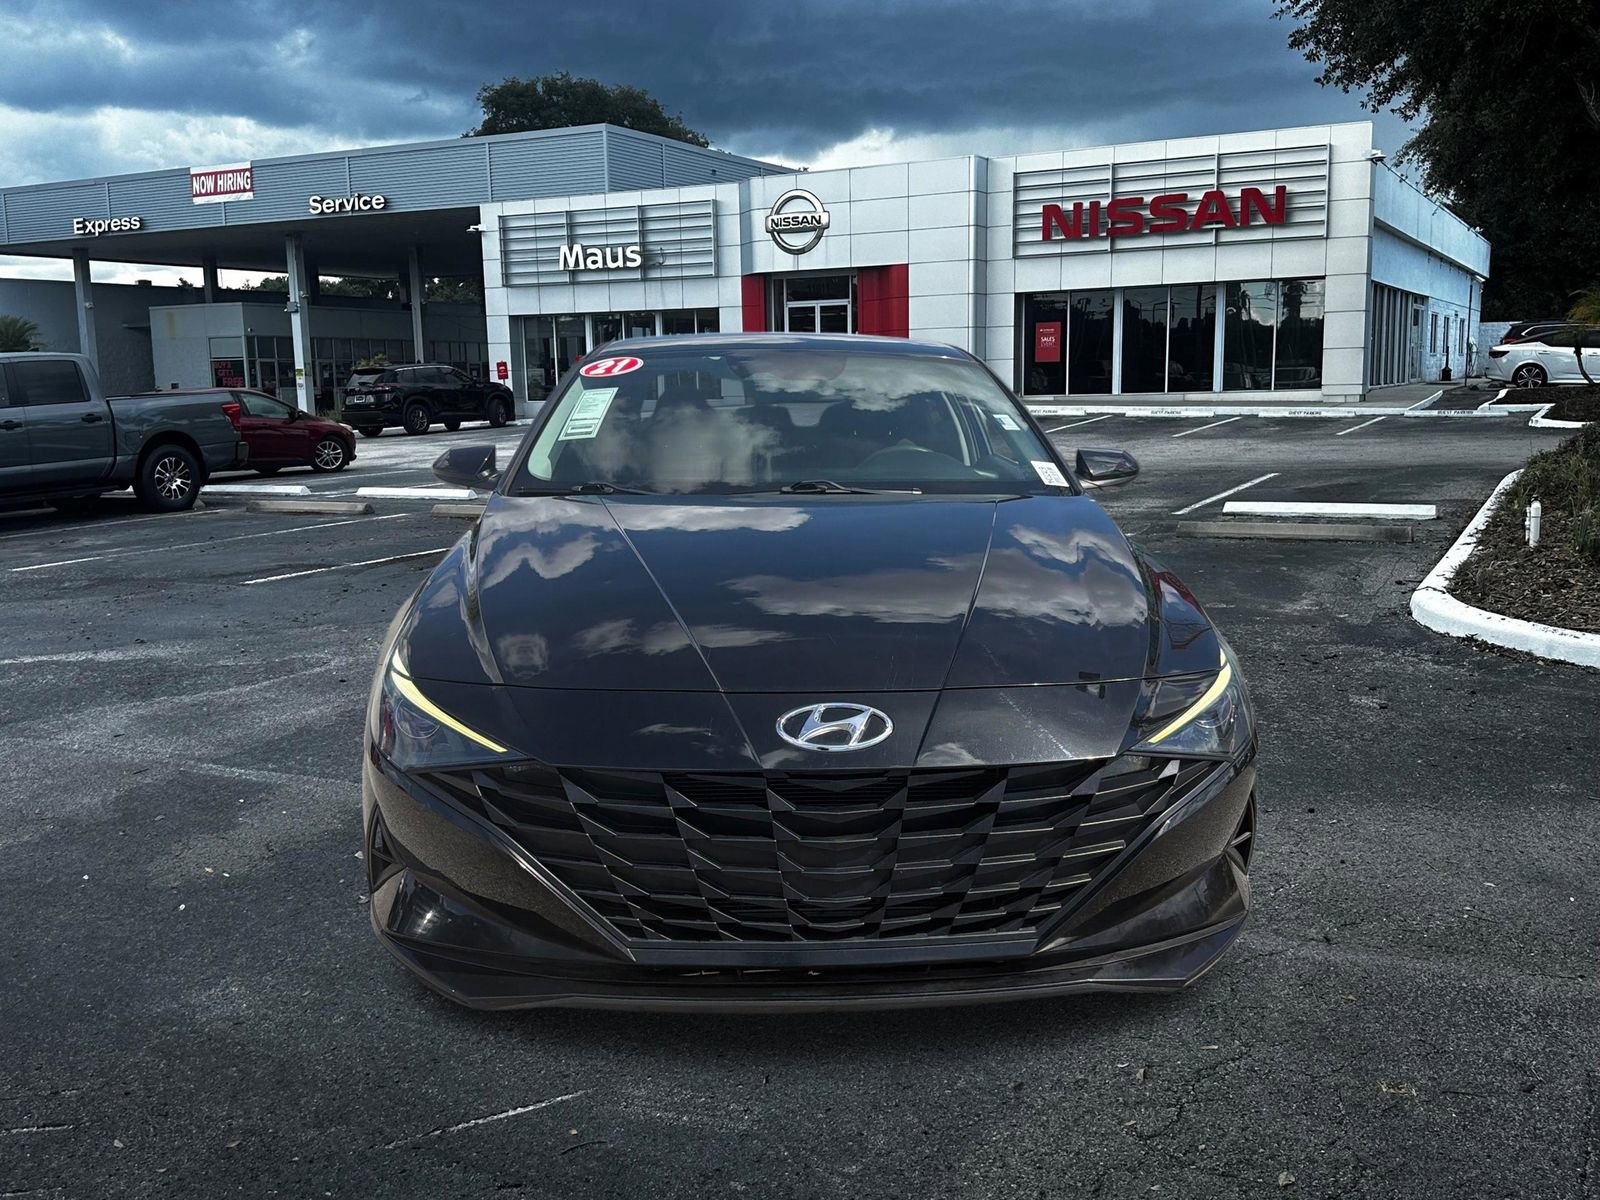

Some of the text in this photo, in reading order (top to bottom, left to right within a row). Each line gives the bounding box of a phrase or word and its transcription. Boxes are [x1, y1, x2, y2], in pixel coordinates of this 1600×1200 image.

[192, 171, 251, 194] NOW HIRING
[309, 193, 385, 214] Service
[1042, 185, 1287, 241] NISSAN
[73, 216, 141, 237] Express
[770, 214, 822, 230] NISSAN
[559, 243, 642, 271] Maus
[588, 358, 632, 375] 21
[222, 377, 244, 386] FREE
